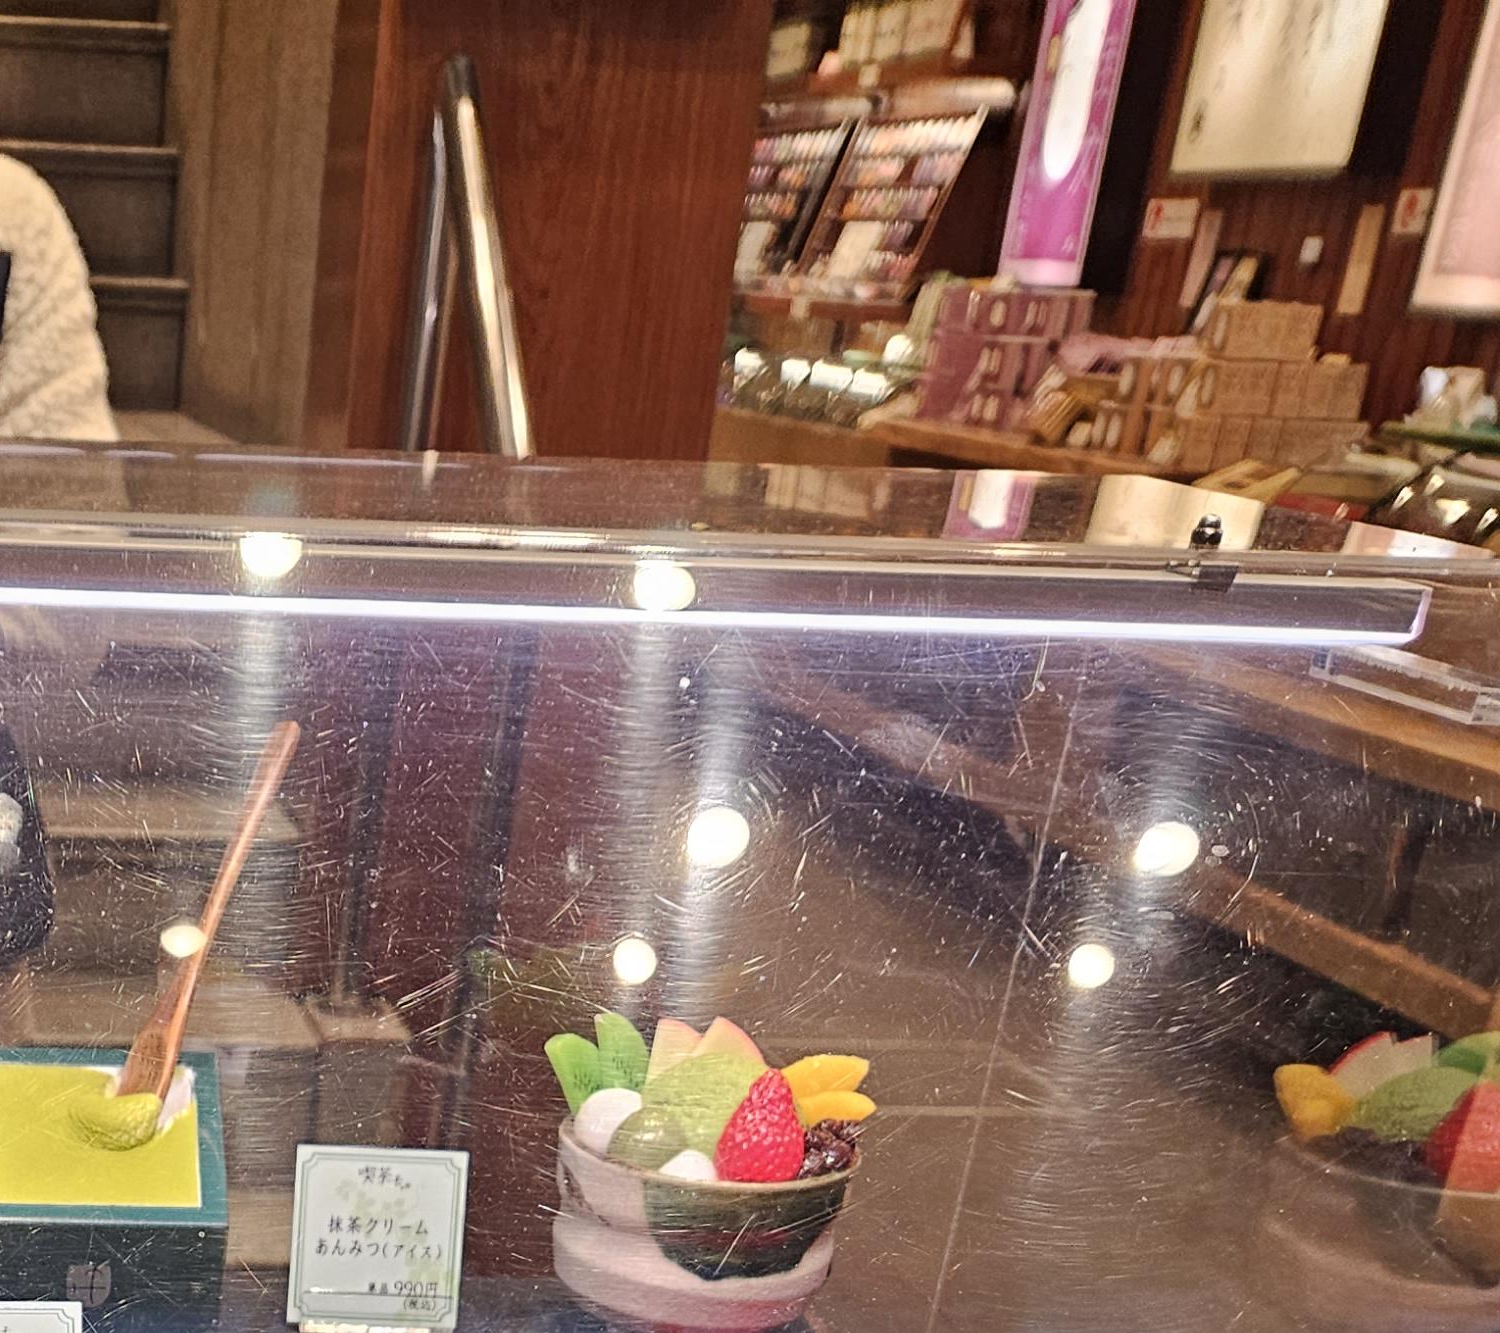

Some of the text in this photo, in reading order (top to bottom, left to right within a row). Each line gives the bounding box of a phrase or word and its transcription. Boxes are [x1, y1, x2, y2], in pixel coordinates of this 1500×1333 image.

[329, 1215, 429, 1235] 抹茶クリーム
